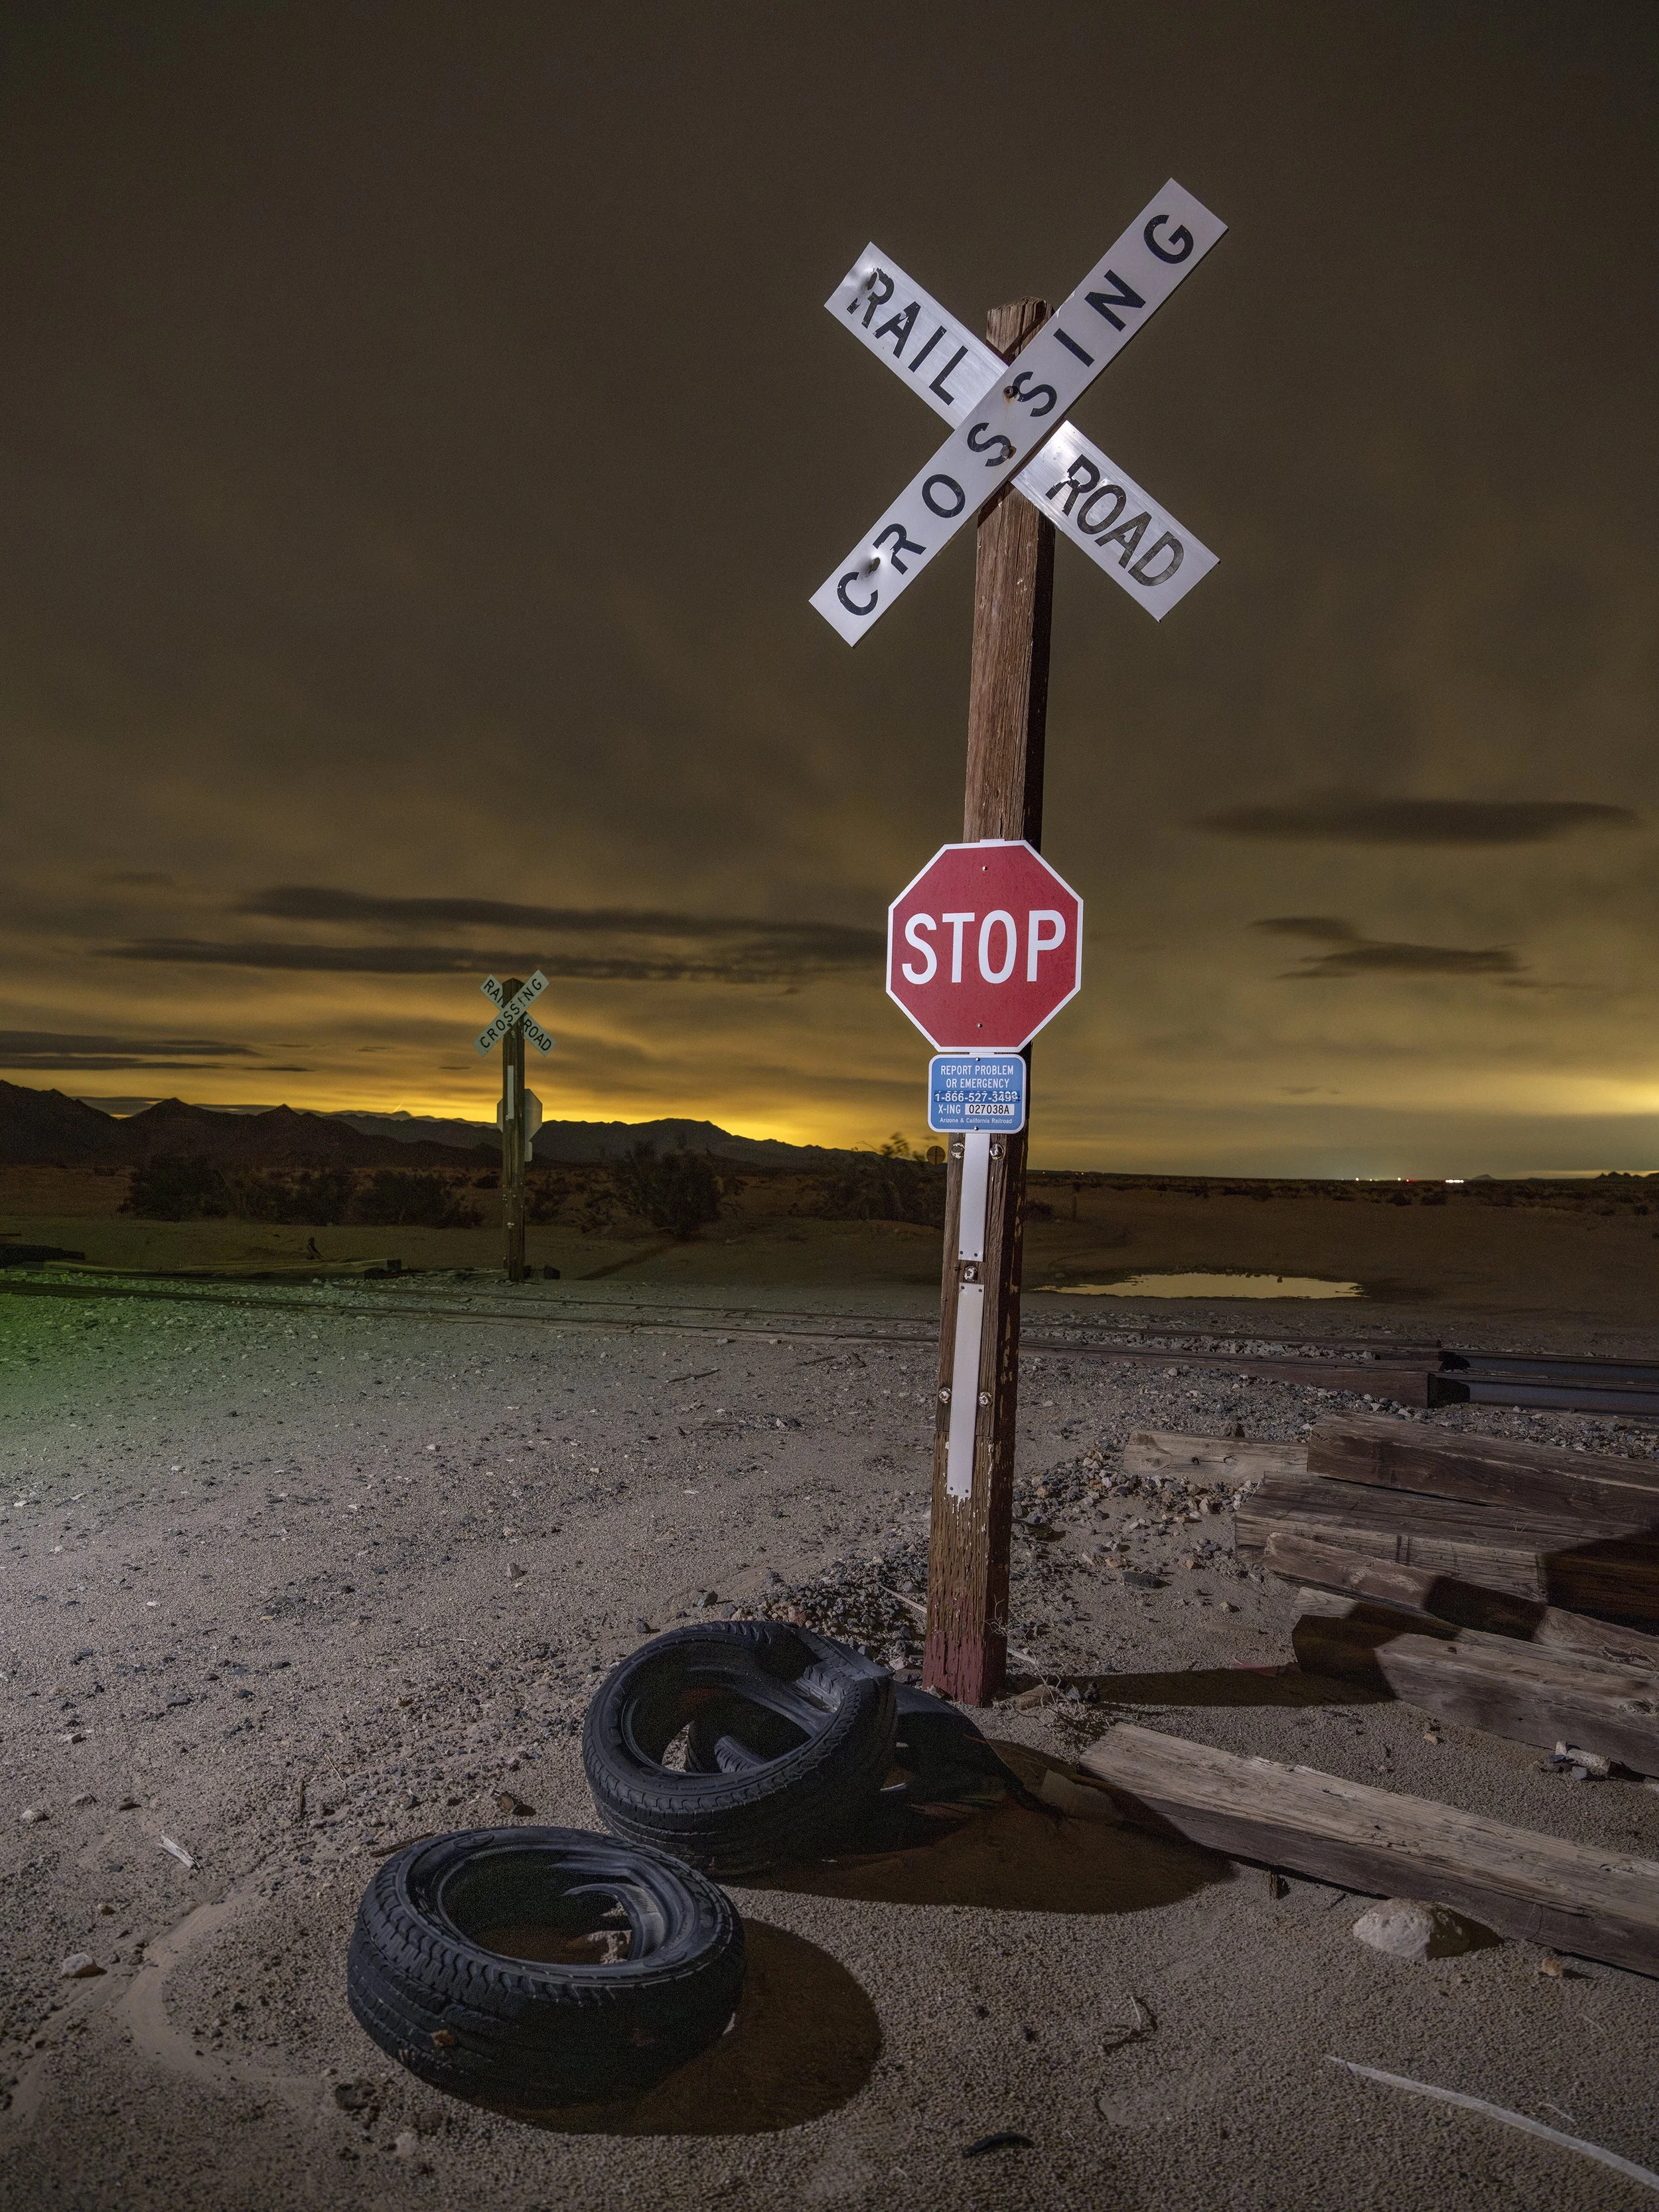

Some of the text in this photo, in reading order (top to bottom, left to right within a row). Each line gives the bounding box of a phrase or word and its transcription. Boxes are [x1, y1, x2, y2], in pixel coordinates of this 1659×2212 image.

[846, 266, 970, 406] RAIL
[836, 214, 1195, 617] CROSSING
[1045, 453, 1185, 587] ROAD
[902, 909, 1066, 985] STOP
[480, 978, 542, 1049] CROSSING
[524, 1018, 552, 1051] ROAD
[940, 1065, 1014, 1075] REPORT PROBLEM
[946, 1078, 1010, 1088] OR EMERGENCY
[938, 1104, 1010, 1114] X-ING 027038A
